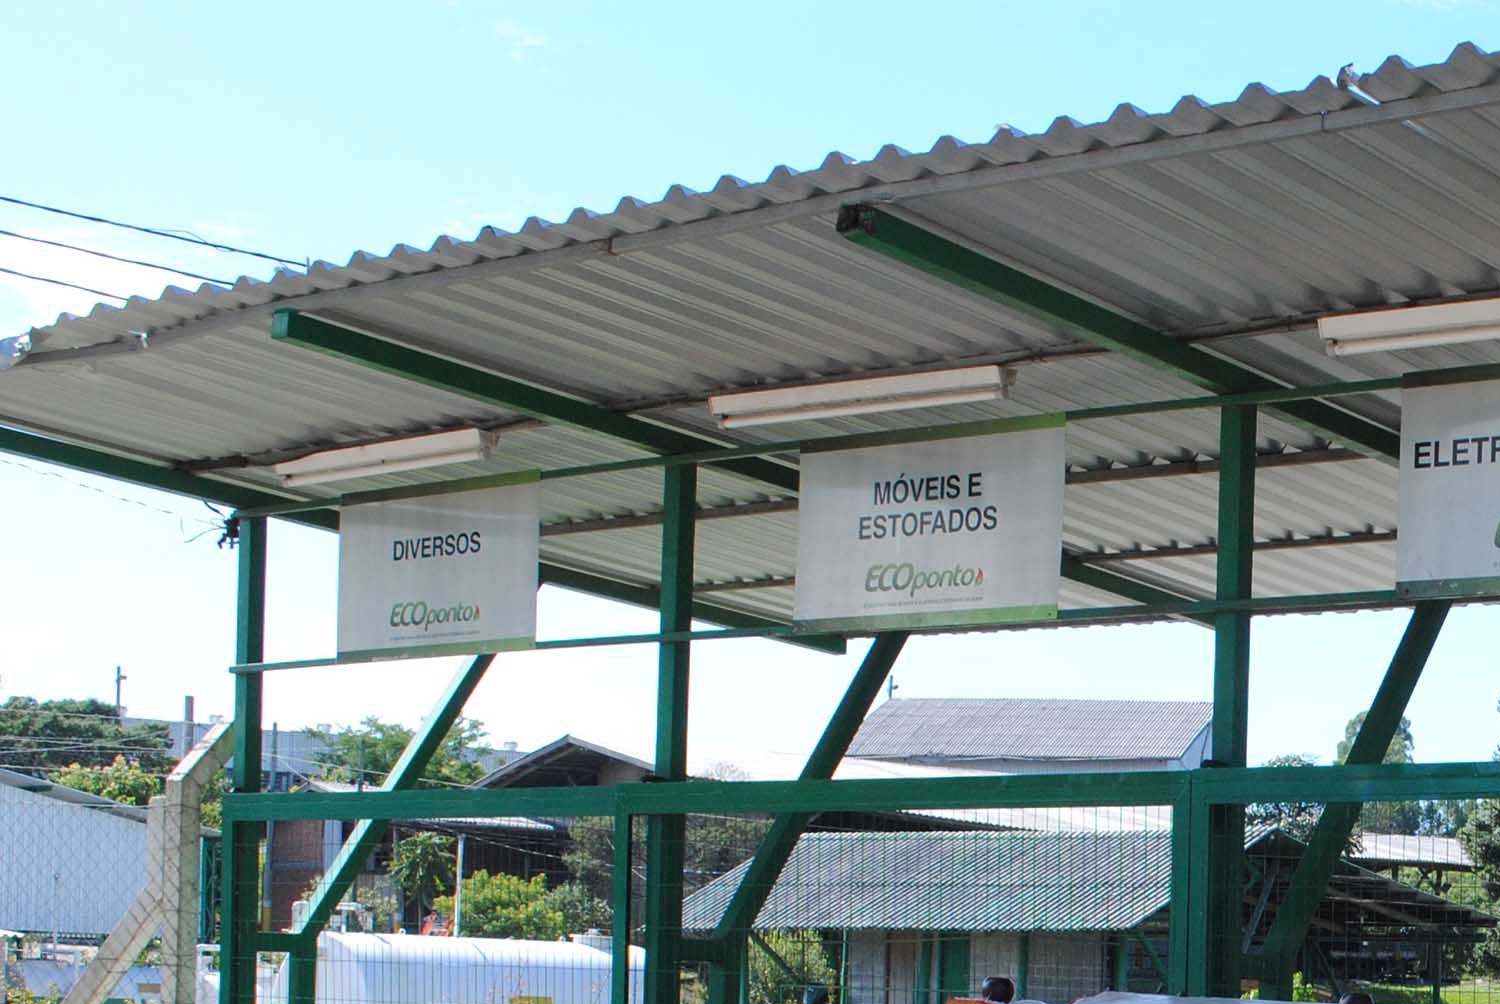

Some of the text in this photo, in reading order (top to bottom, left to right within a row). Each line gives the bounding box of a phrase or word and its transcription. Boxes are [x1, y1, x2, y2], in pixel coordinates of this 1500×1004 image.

[873, 472, 983, 505] MÓVEIS E
[859, 505, 998, 540] ESTOFADOS
[393, 531, 481, 561] DIVERSOS
[864, 562, 976, 598] ECOponto
[390, 601, 474, 632] ECOponto
